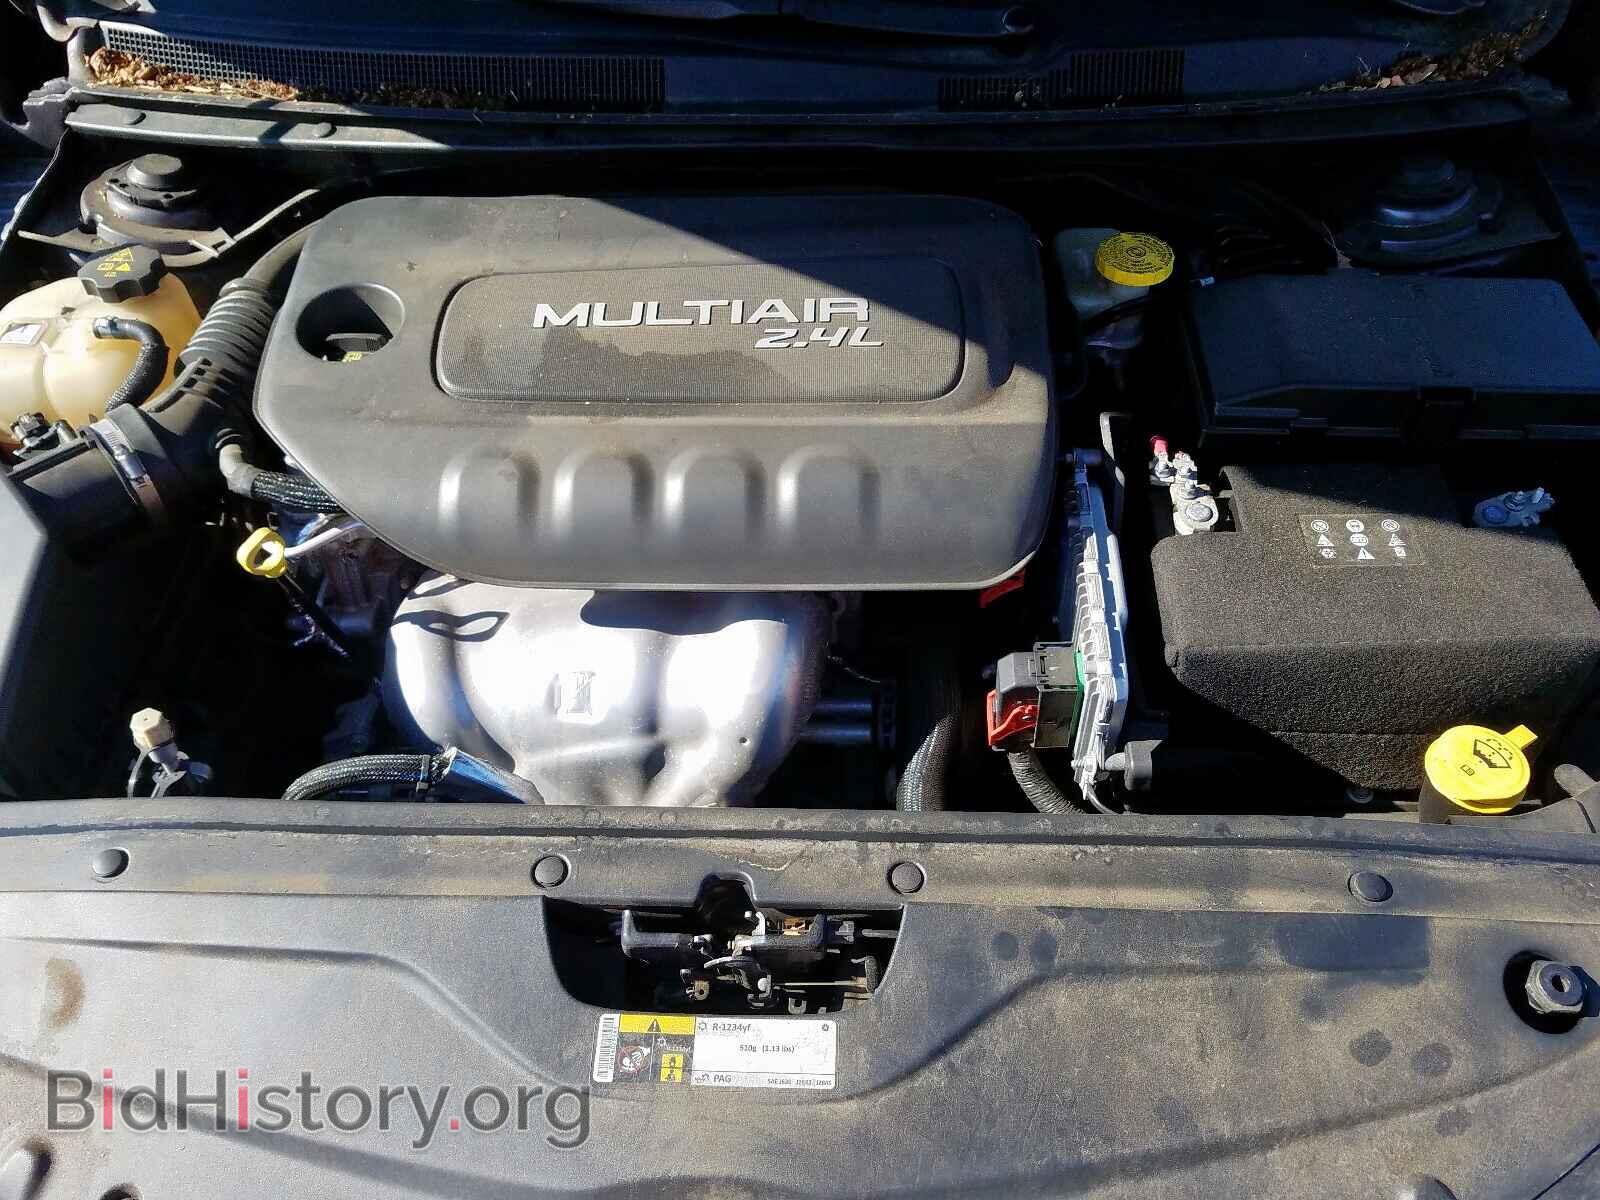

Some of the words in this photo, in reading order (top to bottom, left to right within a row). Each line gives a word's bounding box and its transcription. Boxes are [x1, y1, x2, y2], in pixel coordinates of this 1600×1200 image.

[533, 298, 870, 328] MULTIAIR
[754, 327, 884, 349] 2.4L
[712, 1023, 752, 1033] R-1234yf
[713, 1074, 732, 1083] PAG
